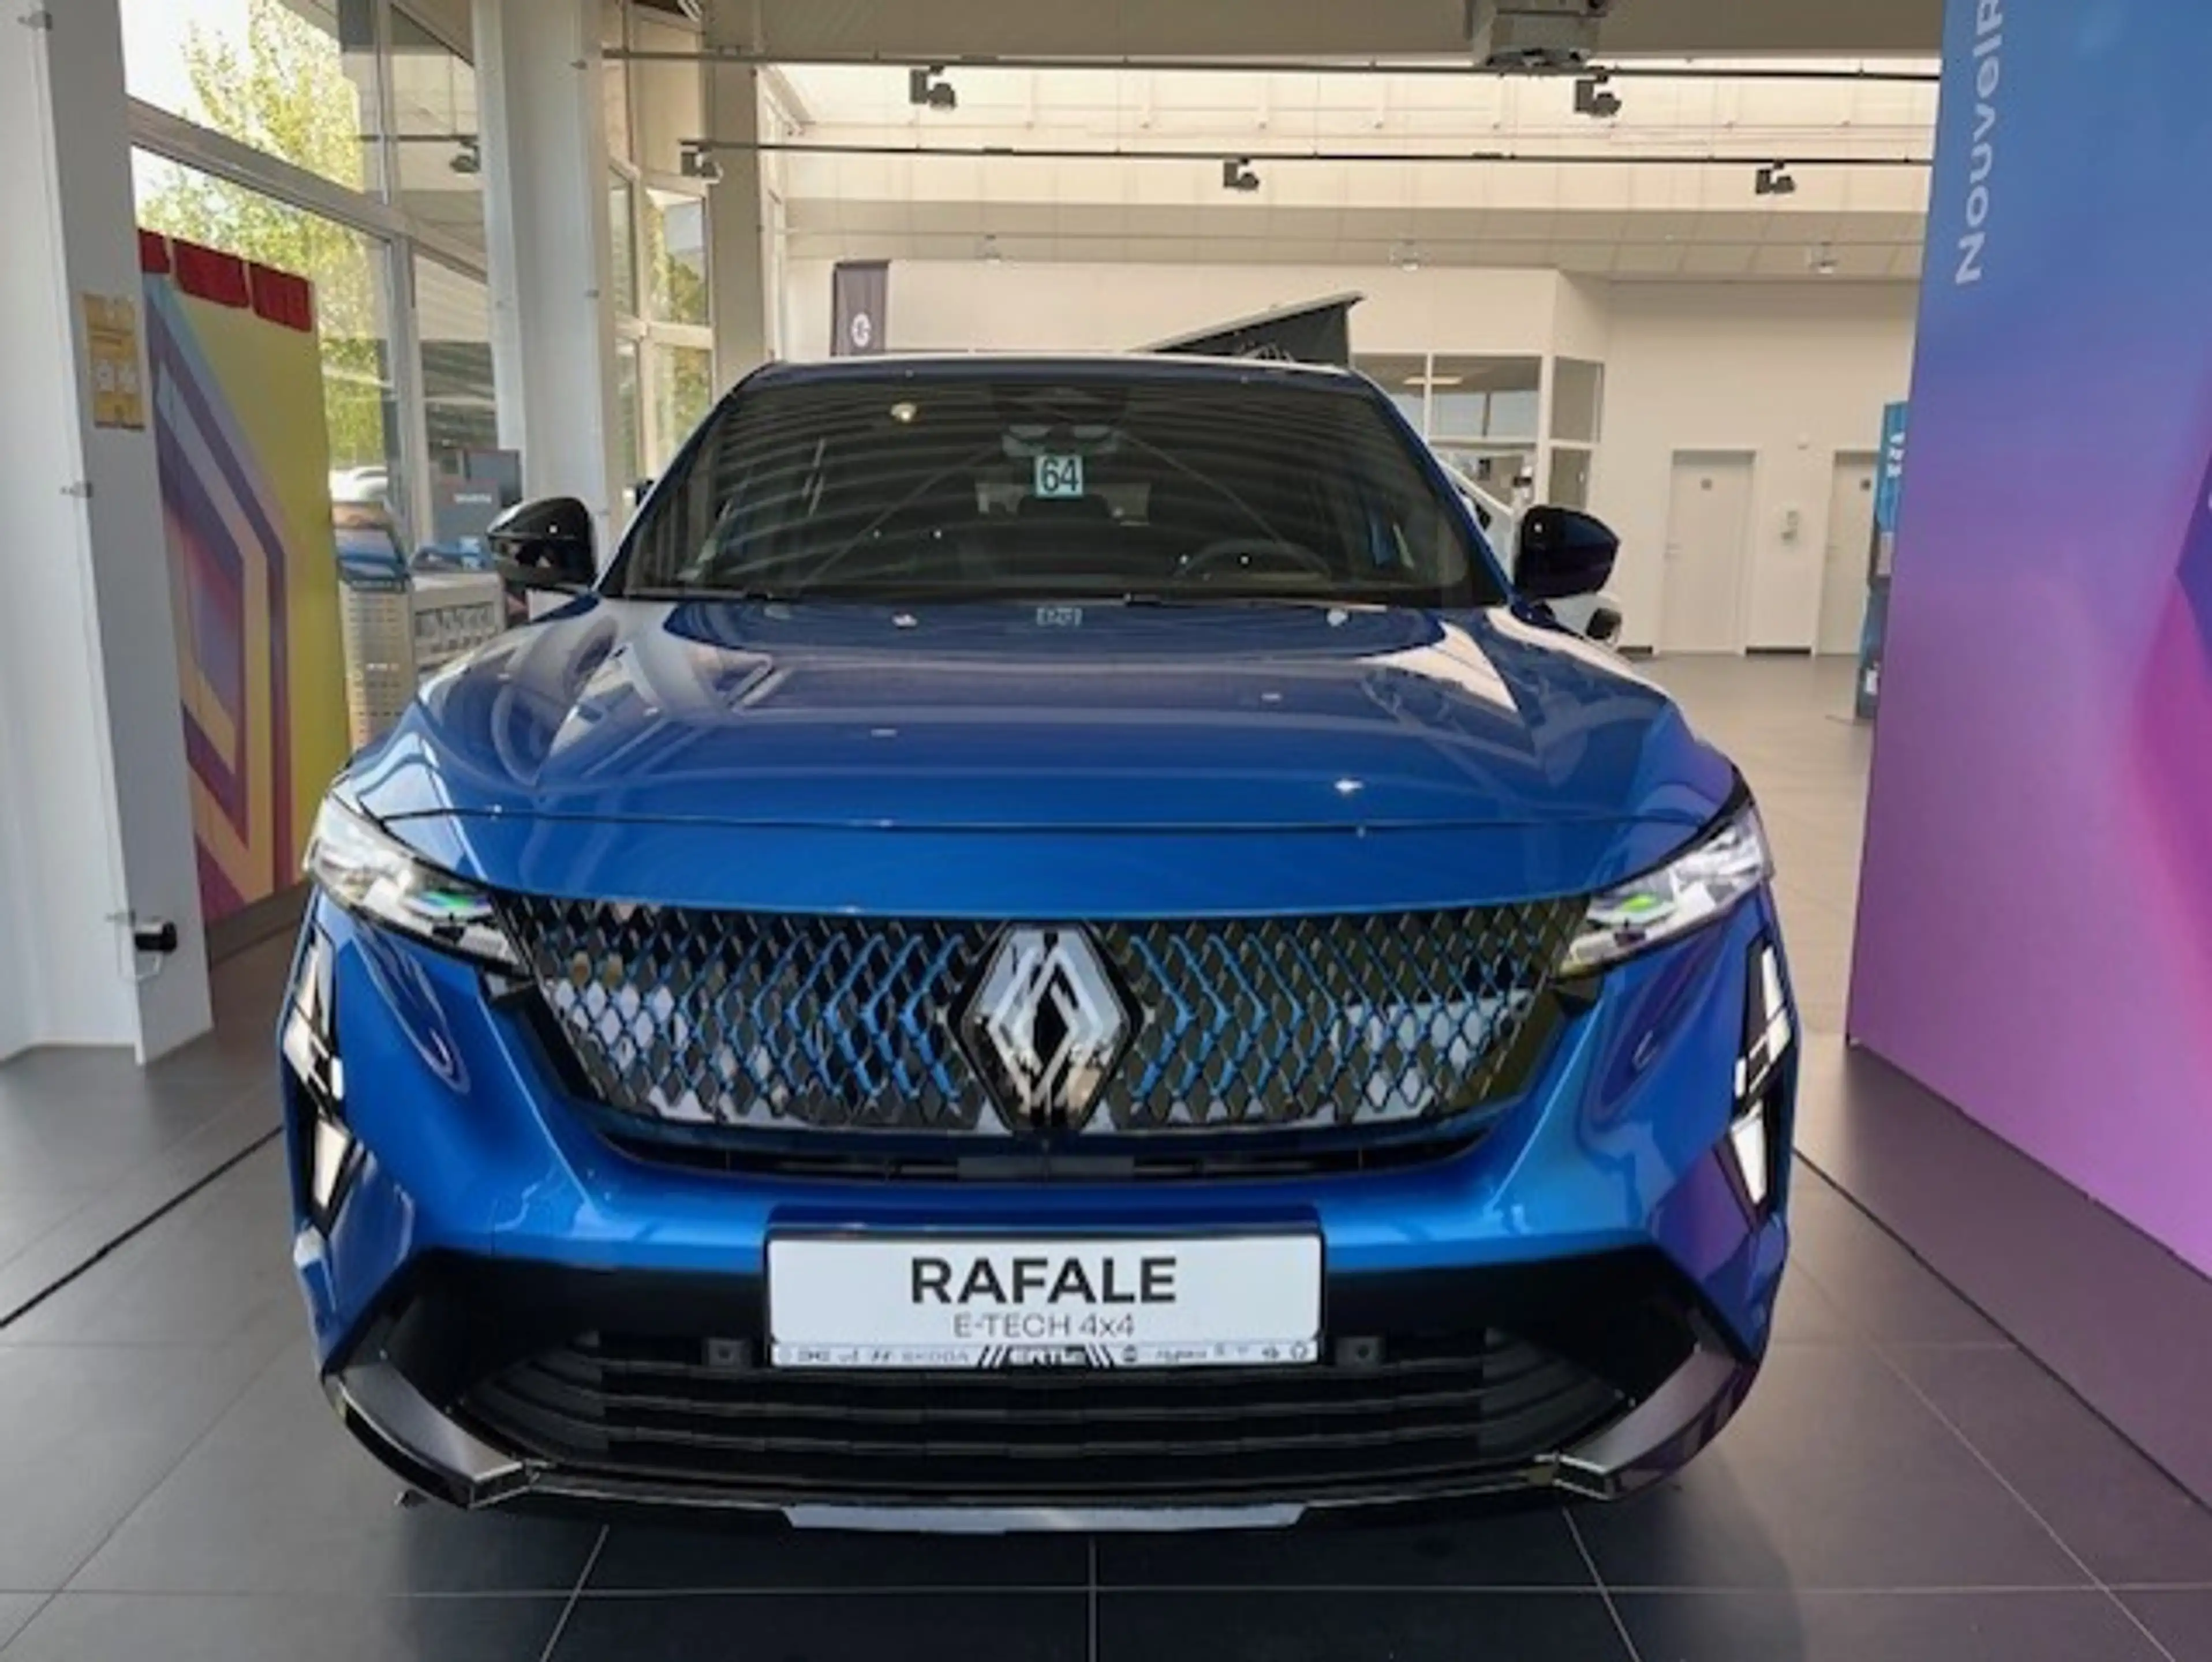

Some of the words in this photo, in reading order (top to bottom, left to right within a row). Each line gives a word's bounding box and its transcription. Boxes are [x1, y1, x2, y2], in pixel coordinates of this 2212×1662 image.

[1040, 459, 1079, 492] 64
[911, 1257, 1176, 1304] RAFALE
[954, 1313, 1070, 1338] E-TECH
[1078, 1313, 1135, 1338] 4x4
